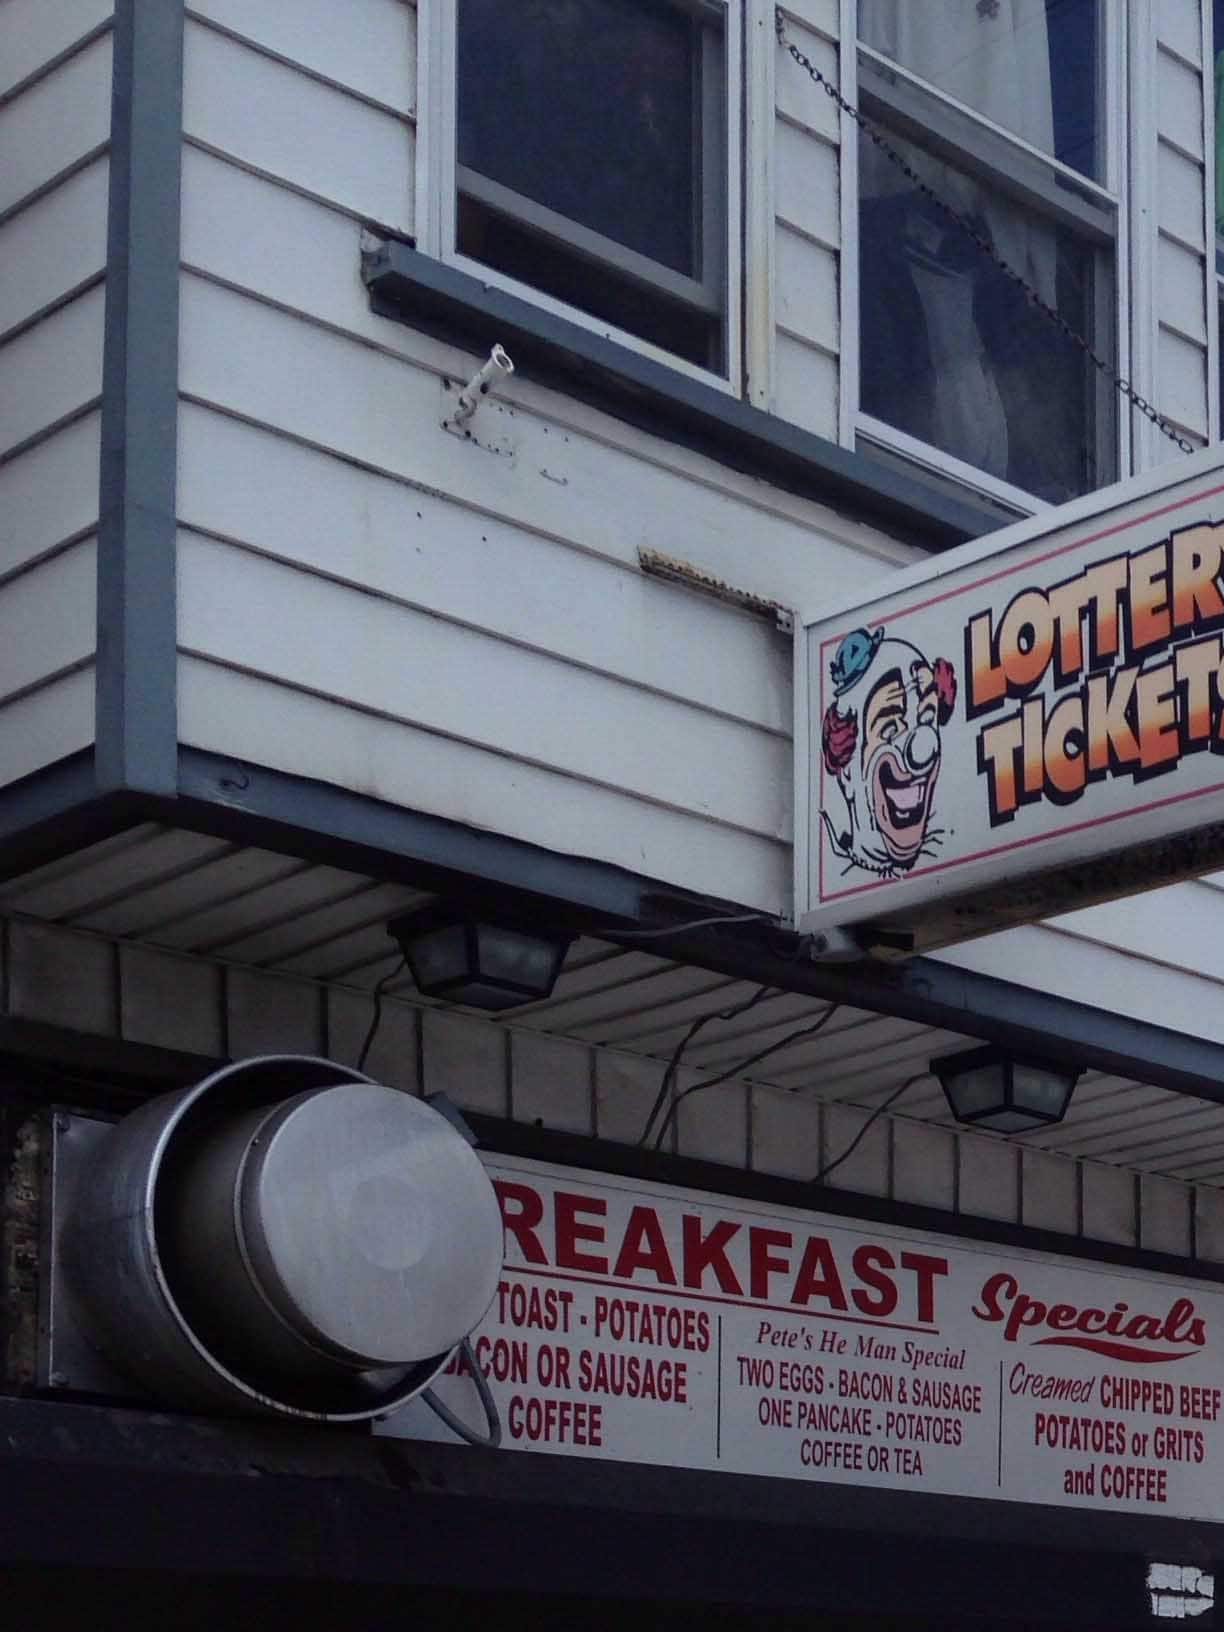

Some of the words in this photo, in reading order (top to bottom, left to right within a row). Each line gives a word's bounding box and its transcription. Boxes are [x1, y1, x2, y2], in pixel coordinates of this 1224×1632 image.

[492, 1179, 948, 1324] REAKFAST
[971, 1272, 1206, 1346] Specials
[498, 1281, 573, 1333] TOAST
[595, 1296, 710, 1352] POTATOES
[756, 1321, 814, 1352] Pete's
[819, 1329, 847, 1355] He
[854, 1335, 896, 1361] Man
[902, 1341, 966, 1371] Special
[537, 1344, 571, 1389] OR
[579, 1350, 687, 1404] SAUSAGE
[737, 1356, 774, 1389] TWO
[779, 1362, 824, 1395] EGGS
[839, 1369, 893, 1403] BACON
[897, 1377, 908, 1405] &
[912, 1380, 982, 1414] SAUSAGE
[1009, 1362, 1096, 1404] Creamed
[1100, 1374, 1174, 1416] CHIPPED
[1180, 1385, 1221, 1421] BEEF
[508, 1395, 602, 1446] COFFEE
[759, 1397, 793, 1428] ONE
[798, 1402, 872, 1436] PANCAKE
[886, 1411, 962, 1446] POTATOES
[1035, 1413, 1126, 1456] POTATOES
[1132, 1431, 1149, 1457] or
[1154, 1426, 1204, 1463] GRITS
[800, 1438, 863, 1470] COFFEE
[867, 1446, 889, 1472] OR
[894, 1448, 923, 1476] TEA
[1064, 1464, 1095, 1496] and
[1101, 1464, 1167, 1503] COFFEE
